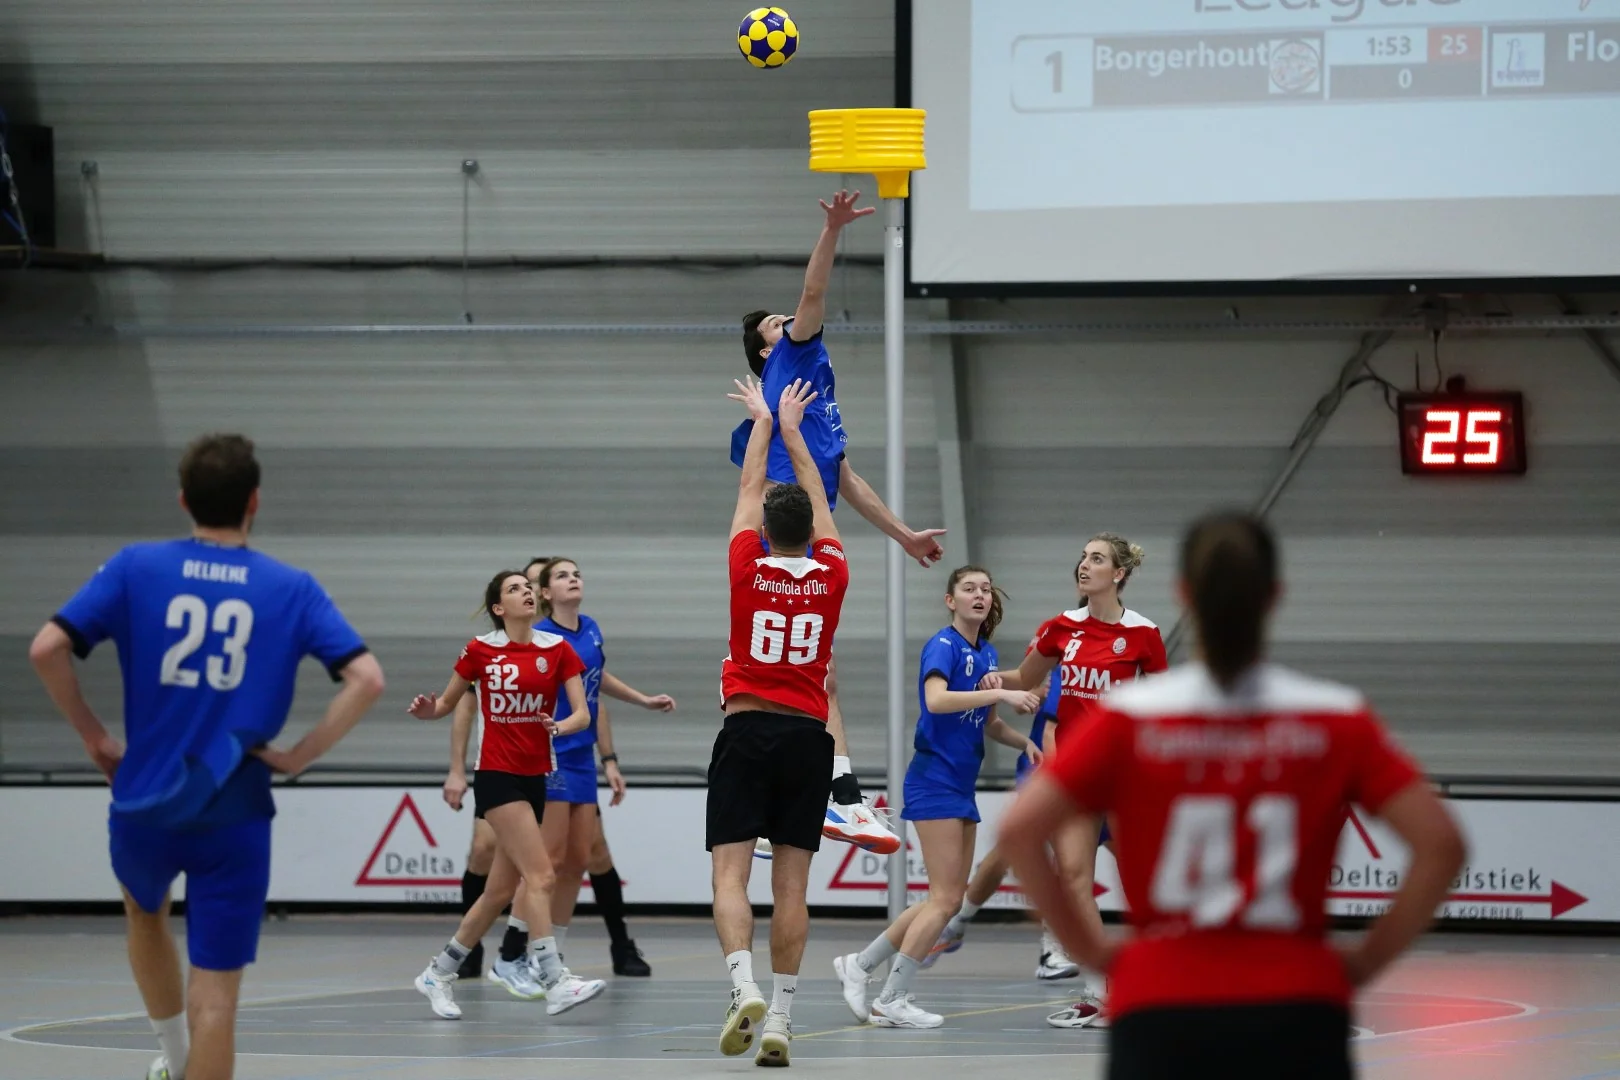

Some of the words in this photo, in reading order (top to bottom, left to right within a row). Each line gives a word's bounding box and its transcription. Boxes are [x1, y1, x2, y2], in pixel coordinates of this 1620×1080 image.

[1366, 36, 1412, 56] 1:53
[1441, 34, 1468, 56] 25
[1567, 30, 1620, 62] Flo
[1044, 51, 1063, 93] 1
[1096, 42, 1268, 77] Borgerhout
[1398, 68, 1412, 89] 0
[1422, 411, 1501, 464] 25
[753, 573, 801, 595] Pantofola
[804, 579, 828, 595] d'Oro
[160, 594, 254, 692] 23
[750, 610, 824, 666] 69
[1063, 639, 1083, 662] 8
[485, 664, 519, 691] 32
[385, 852, 455, 876] Delta
[1151, 794, 1301, 928] 41
[1329, 864, 1398, 887] Delta
